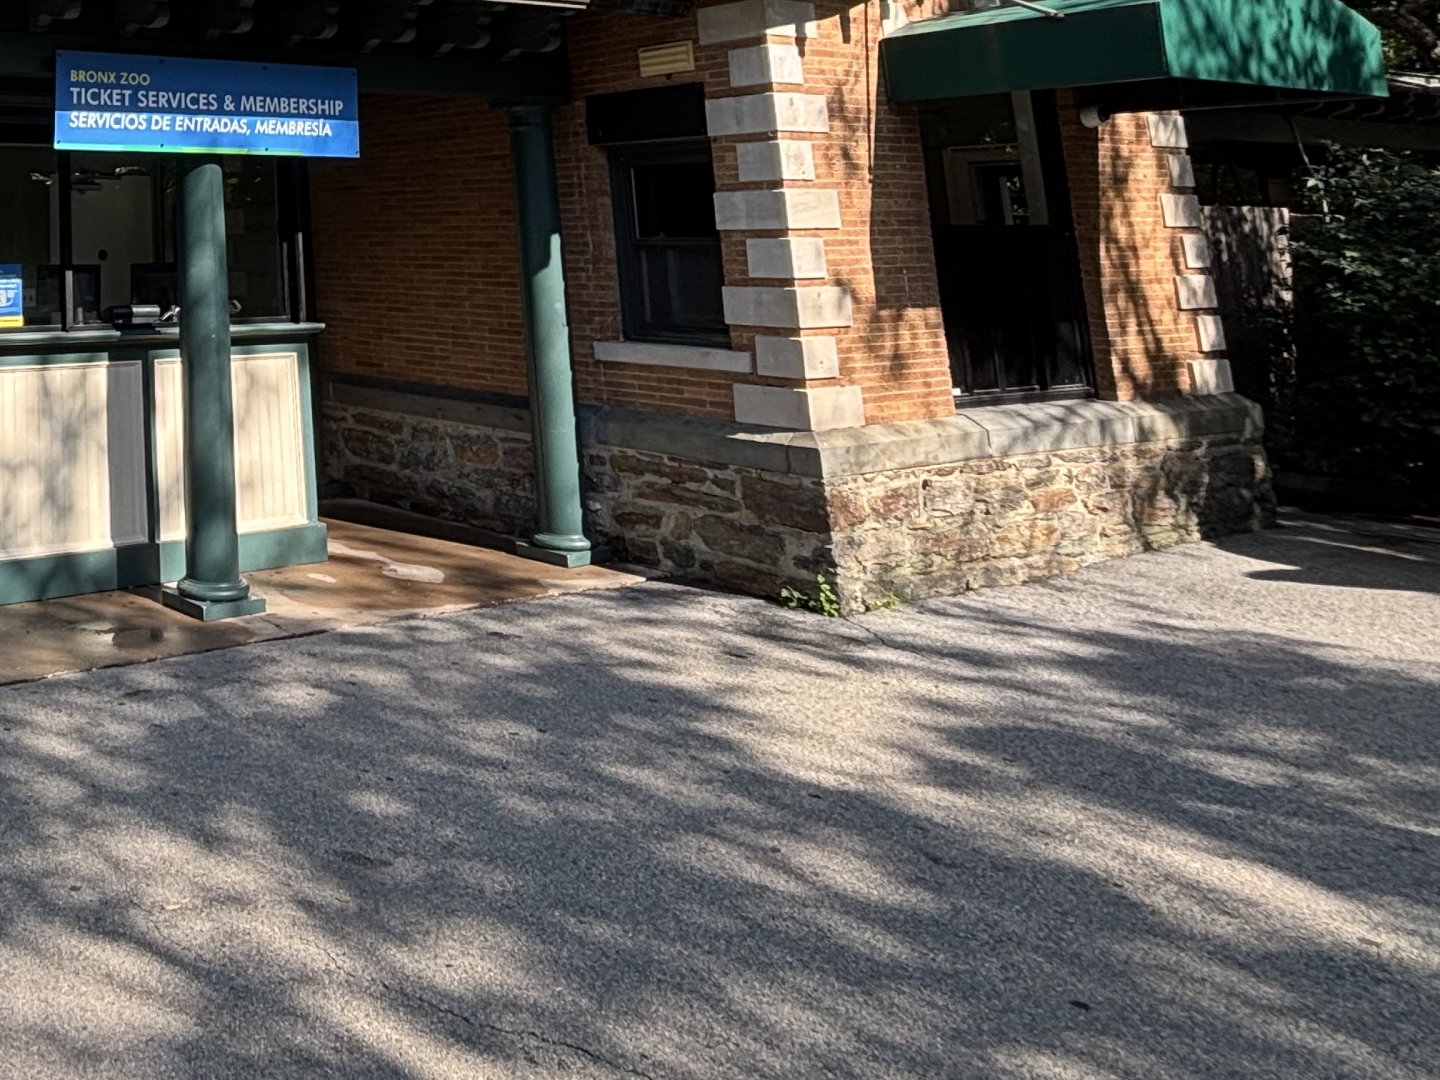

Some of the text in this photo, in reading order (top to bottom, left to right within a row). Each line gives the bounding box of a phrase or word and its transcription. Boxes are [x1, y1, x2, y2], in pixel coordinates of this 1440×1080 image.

[70, 69, 150, 86] BRONX ZOO
[70, 87, 344, 116] TICKET SERVICES & MEMBERSHIP
[69, 110, 332, 137] SERVICIOS DE ENTRADAS, MEMBRESÍA
